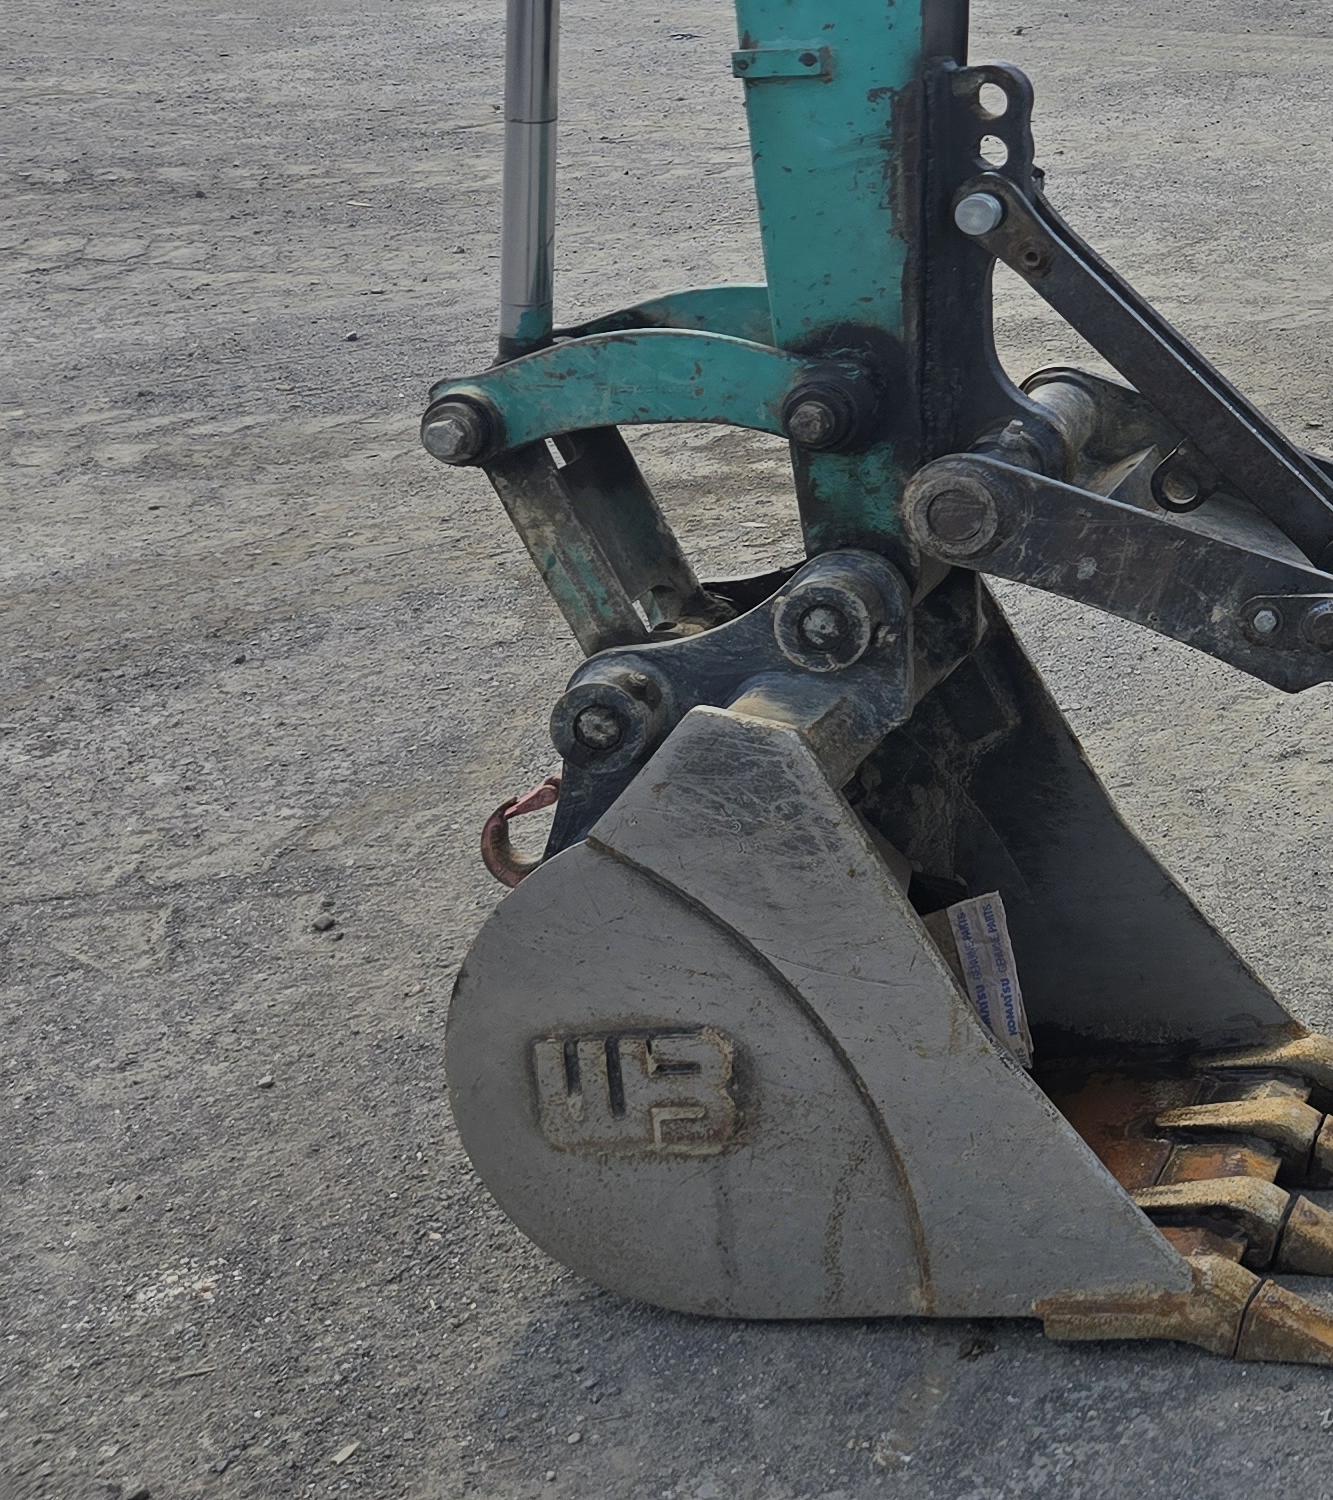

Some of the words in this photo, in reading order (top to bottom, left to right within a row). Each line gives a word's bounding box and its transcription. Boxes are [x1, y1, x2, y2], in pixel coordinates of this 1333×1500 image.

[956, 911, 973, 941] PARTS
[981, 903, 998, 933] PARTS
[976, 984, 991, 1025] MATSU
[1000, 977, 1018, 1037] KOMATSU
